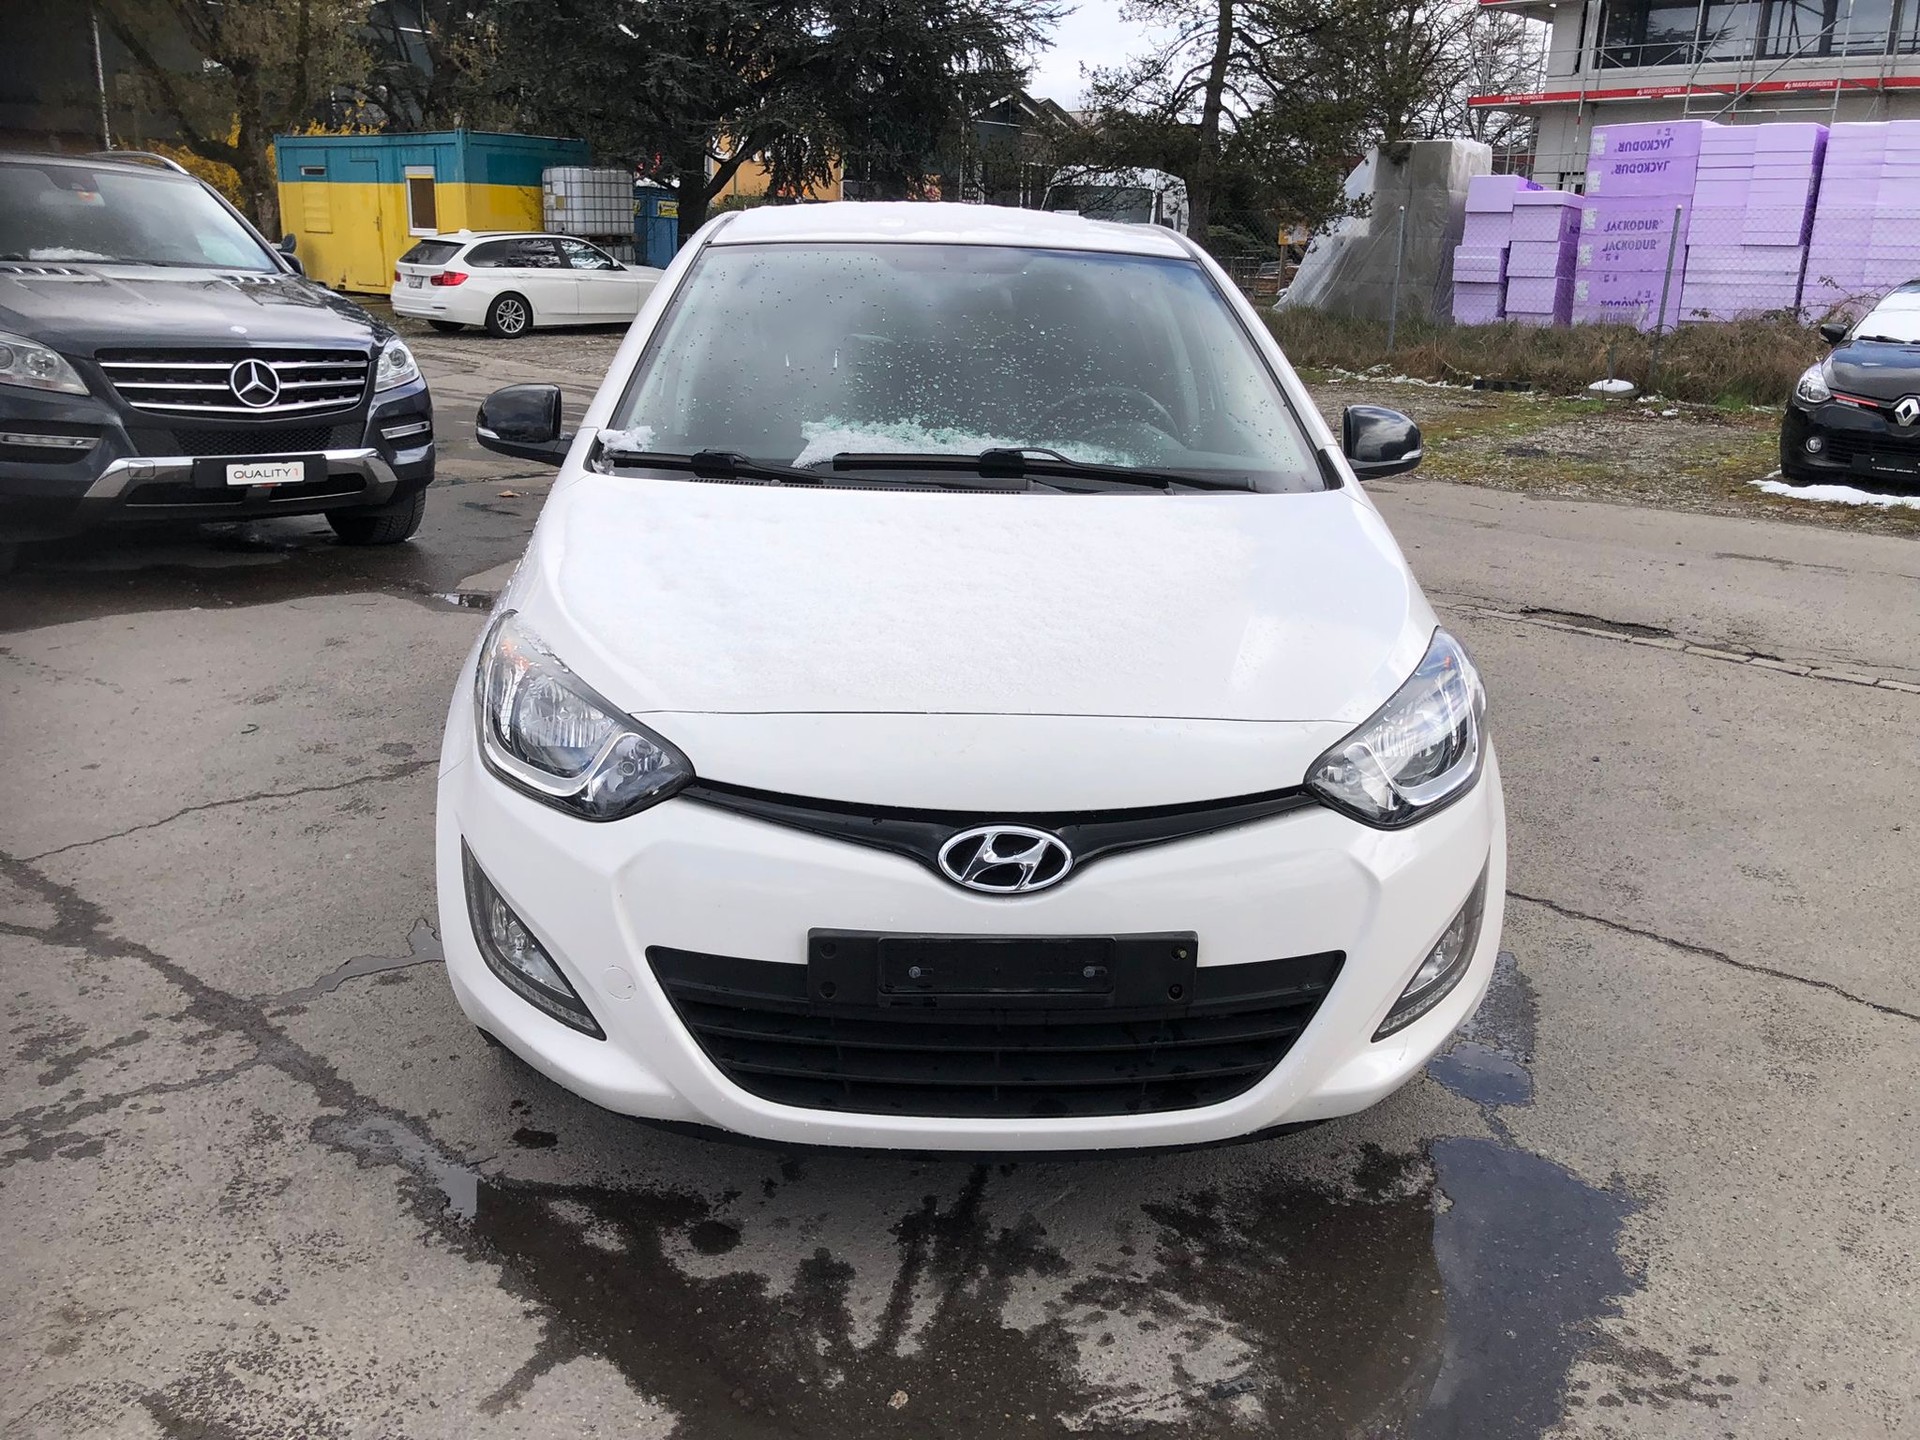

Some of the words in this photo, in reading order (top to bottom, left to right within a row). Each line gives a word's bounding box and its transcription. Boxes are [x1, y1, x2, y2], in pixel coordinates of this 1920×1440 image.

[1617, 137, 1674, 153] JACKODUR
[1614, 160, 1671, 175] JACKODUR
[1603, 219, 1660, 232] JACKODUR
[1601, 239, 1657, 252] JACKODUR
[233, 468, 291, 479] QUALITY
